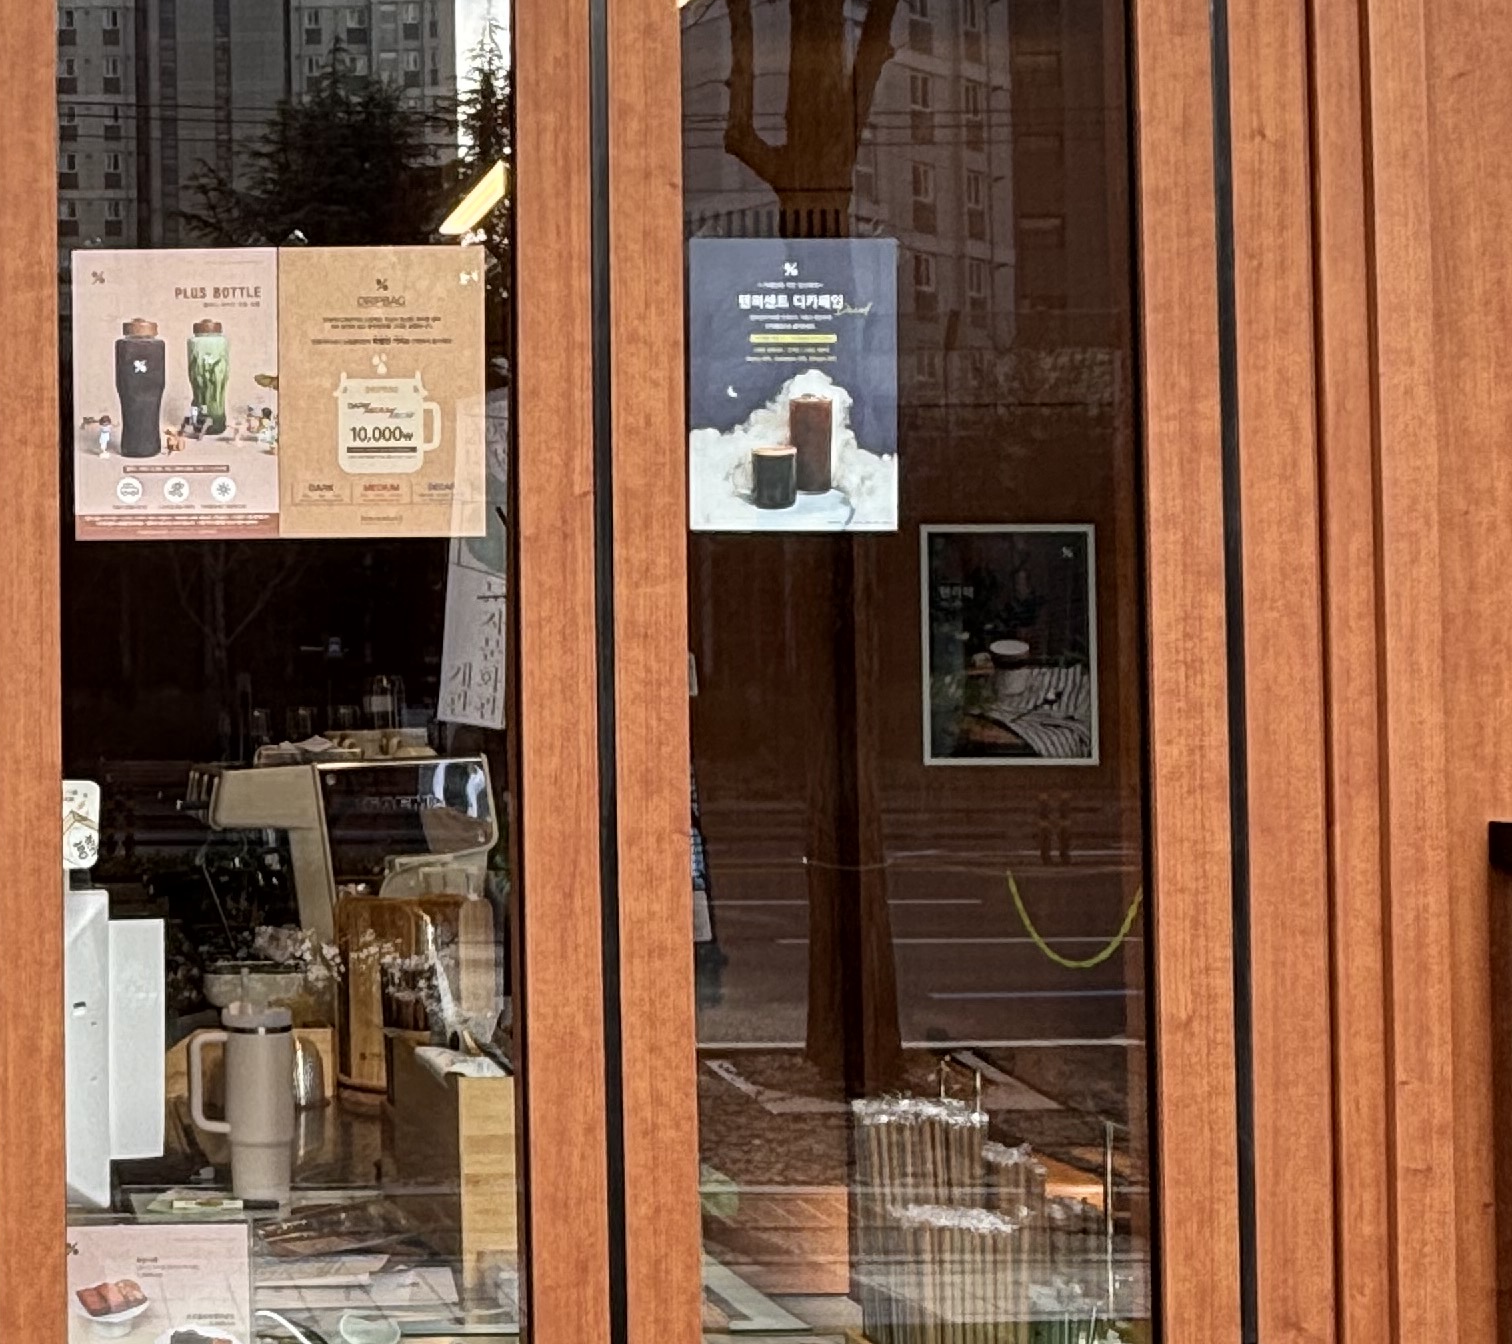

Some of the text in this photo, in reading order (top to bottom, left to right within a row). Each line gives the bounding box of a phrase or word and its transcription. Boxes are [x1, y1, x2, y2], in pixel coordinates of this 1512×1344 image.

[175, 285, 262, 300] PLUS BOTTLE
[357, 296, 406, 307] DRIPBAG
